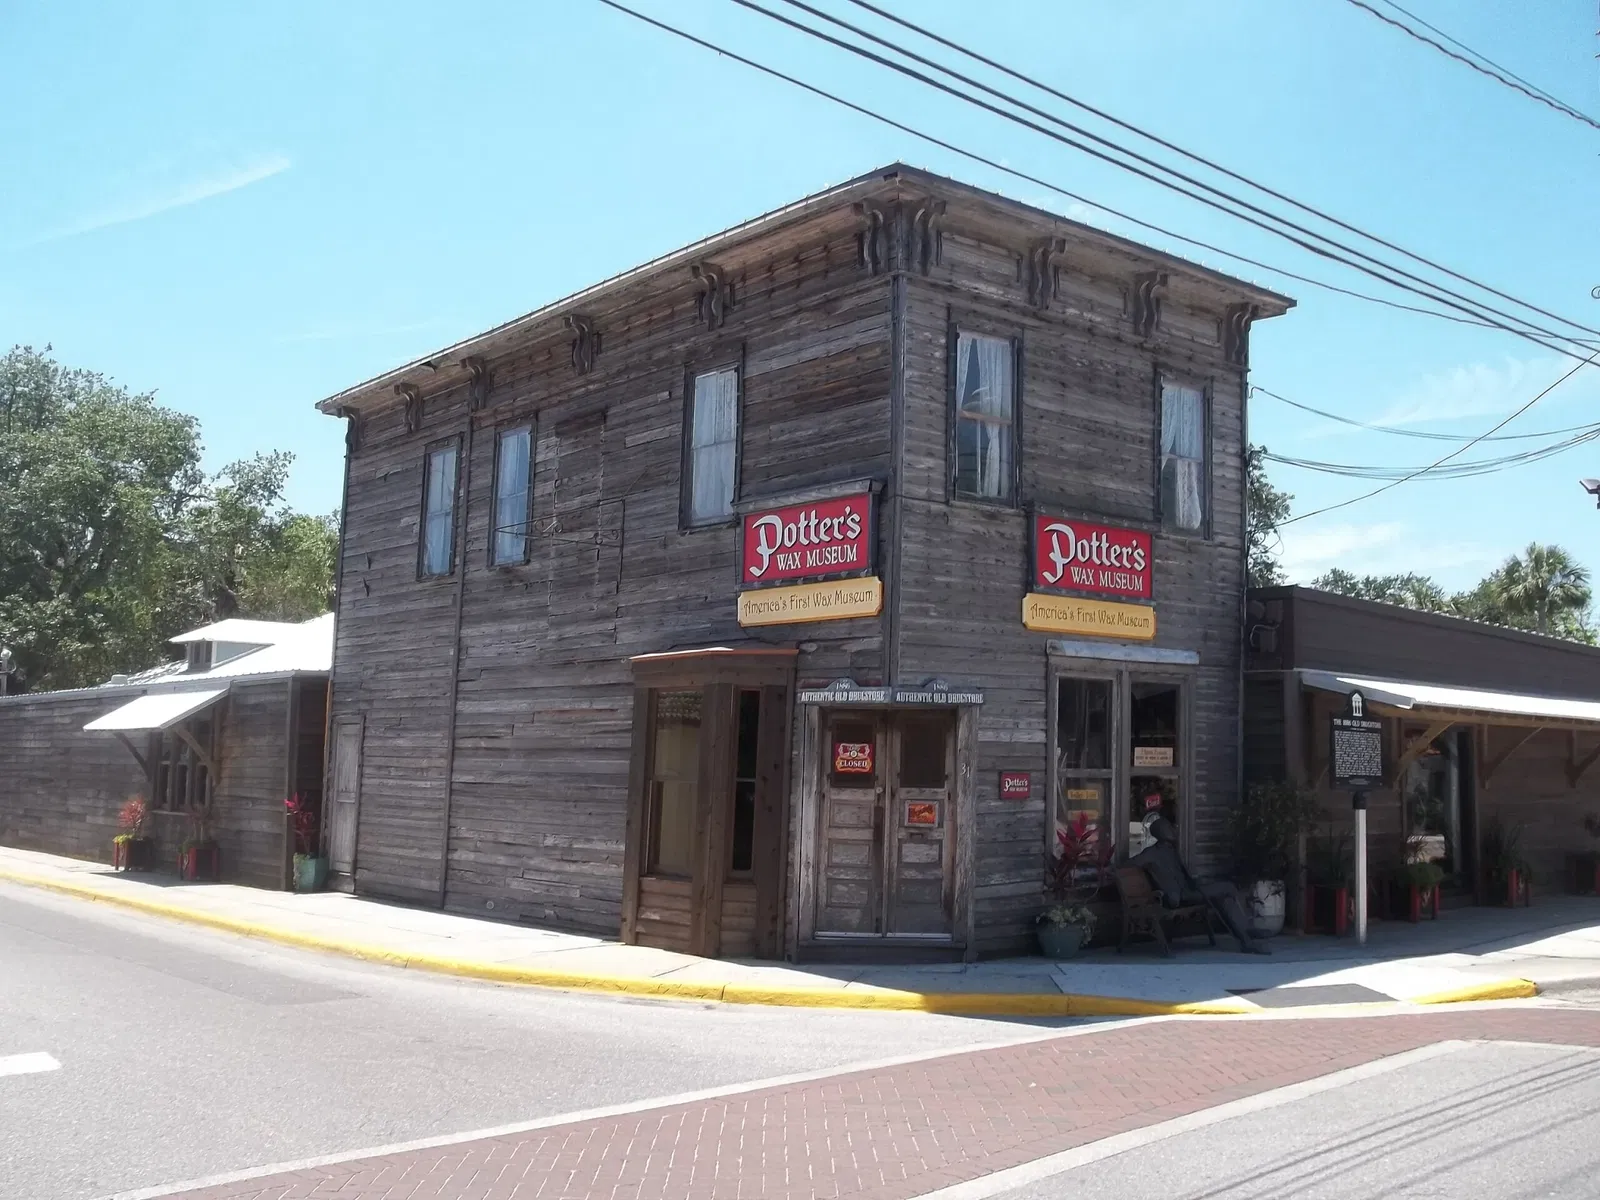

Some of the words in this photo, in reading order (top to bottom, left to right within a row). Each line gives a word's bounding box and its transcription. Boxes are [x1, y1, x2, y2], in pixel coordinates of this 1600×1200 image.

[749, 505, 862, 578] Potter's
[1042, 523, 1147, 584] Potter's
[776, 551, 802, 571] WAX
[806, 543, 858, 568] MUSEUM
[1070, 566, 1095, 586] WAX
[1099, 570, 1144, 592] MUSEUM
[743, 596, 787, 617] America's
[790, 593, 811, 610] First
[813, 591, 833, 608] Wax
[834, 588, 874, 606] Museum
[1030, 602, 1075, 620] America's
[1077, 607, 1096, 623] First
[1098, 609, 1116, 626] Wax
[1117, 611, 1150, 629] Museum
[801, 691, 834, 702] AUTHENTIC
[835, 691, 848, 702] OLD
[848, 690, 885, 702] DRUGSTORE
[896, 691, 933, 703] AUTHENTIC
[933, 692, 947, 703] OLD
[947, 693, 984, 704] DRUGSTORE
[840, 759, 867, 768] CLOSED
[960, 762, 970, 779] 31
[1004, 777, 1028, 792] Potter's
